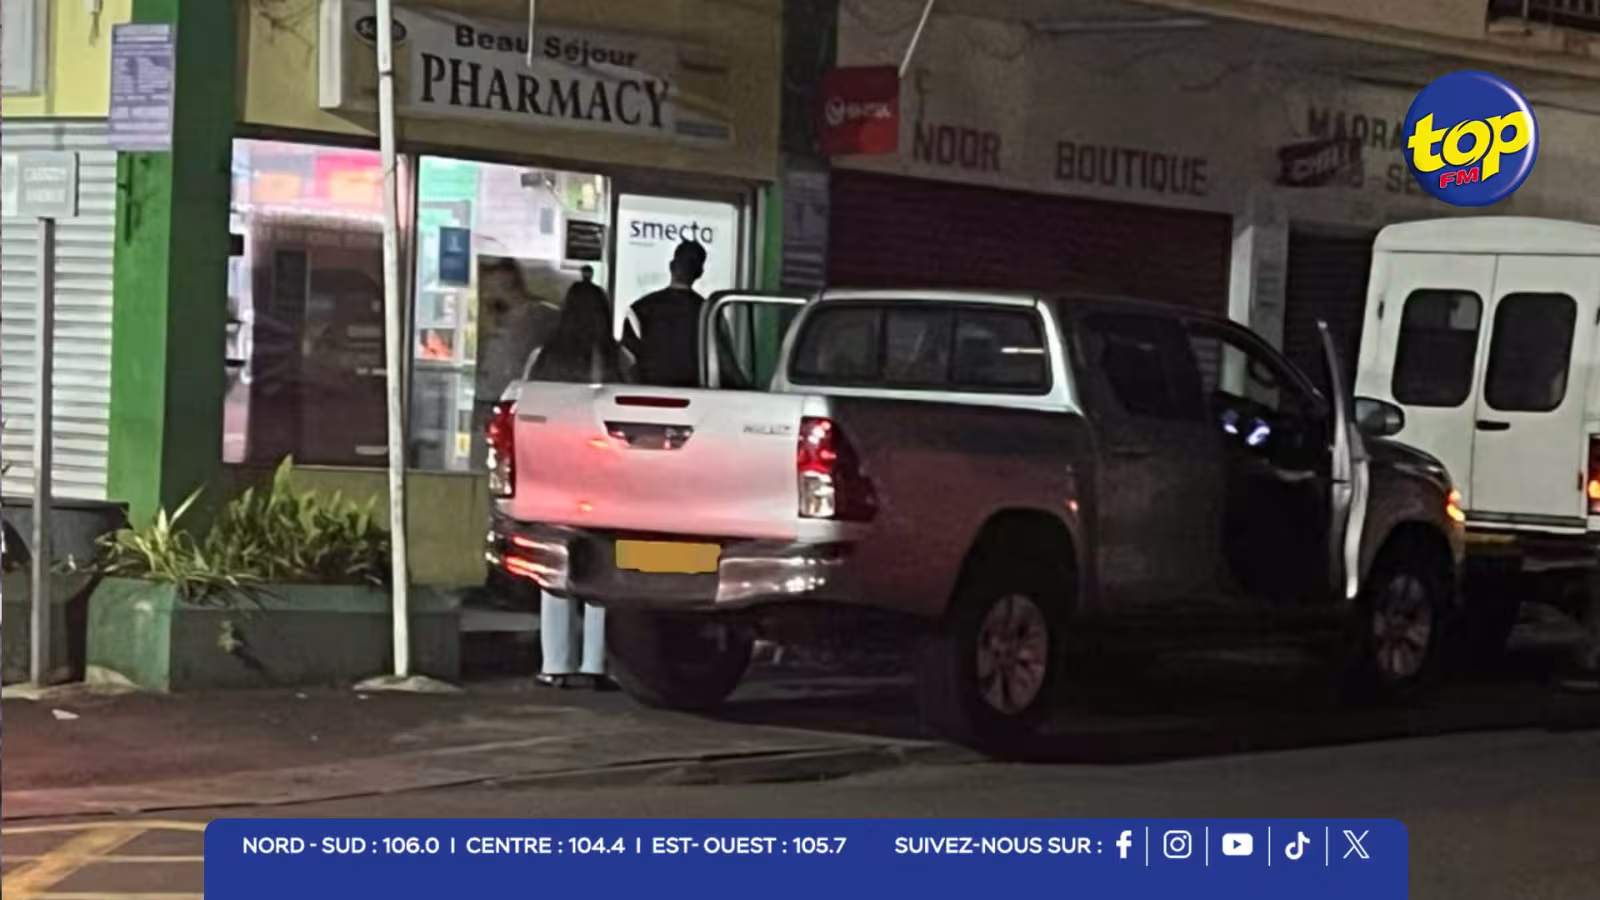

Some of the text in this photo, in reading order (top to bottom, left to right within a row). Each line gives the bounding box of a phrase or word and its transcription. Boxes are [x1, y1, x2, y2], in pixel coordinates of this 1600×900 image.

[454, 24, 530, 54] Beau
[420, 52, 671, 128] PHARMACY
[911, 120, 1209, 197] NOOR BOUTIQUE
